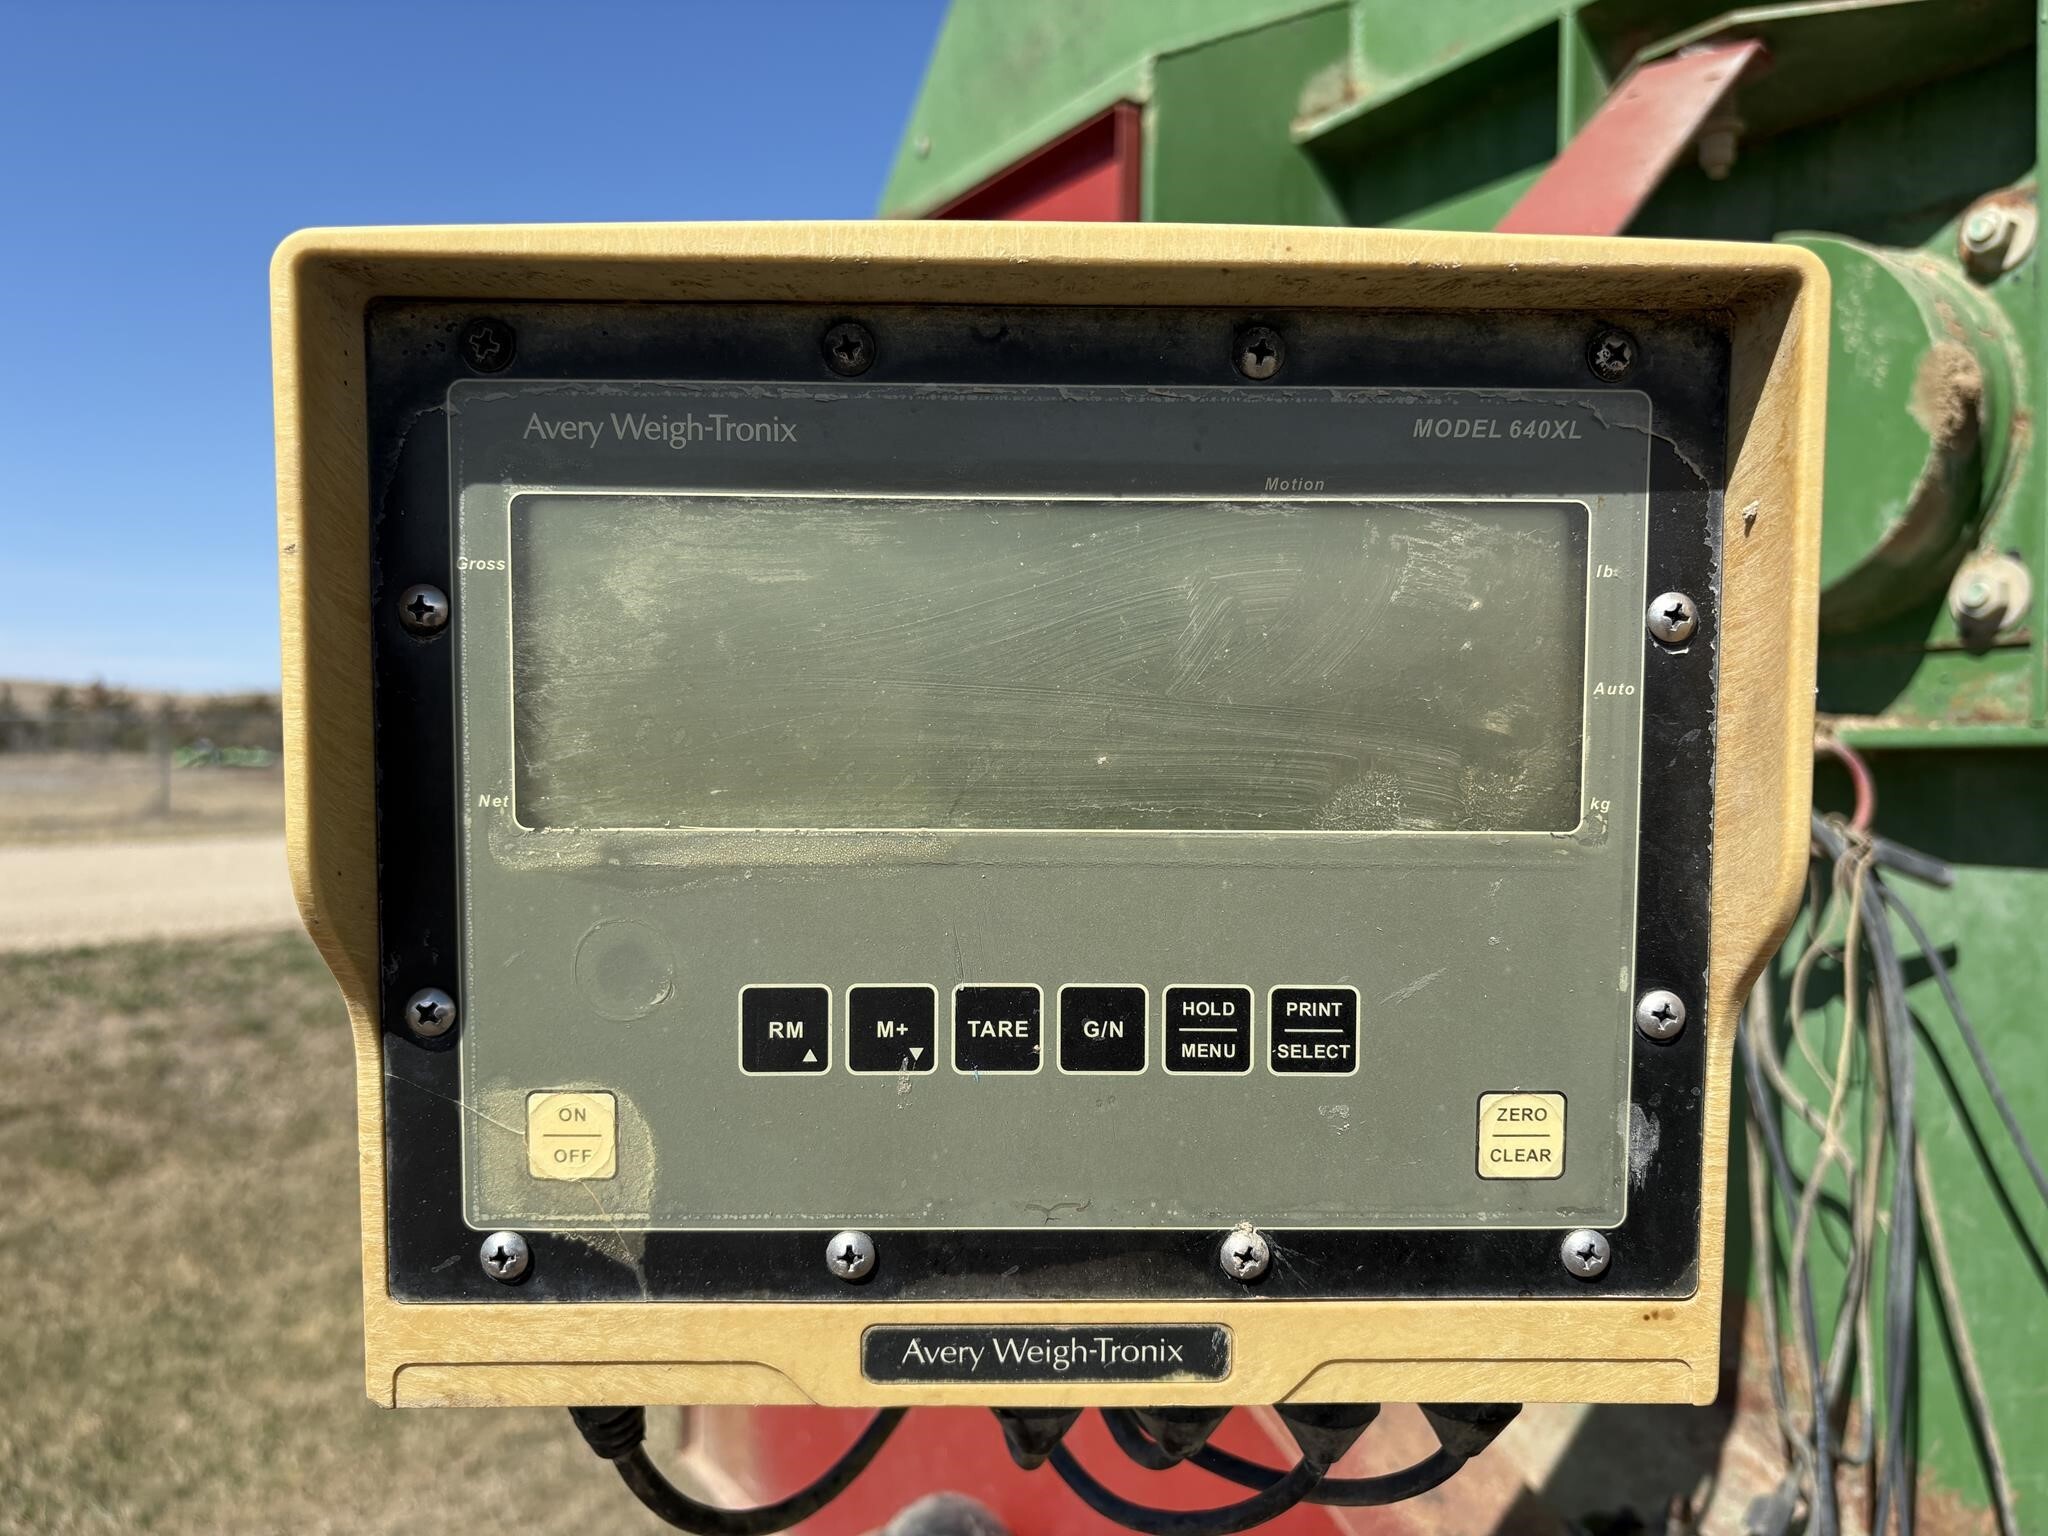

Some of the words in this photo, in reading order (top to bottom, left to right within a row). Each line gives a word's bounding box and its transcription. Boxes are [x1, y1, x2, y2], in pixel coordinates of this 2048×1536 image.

[522, 412, 604, 448] Avery
[610, 413, 798, 450] Weigh-Tronix
[1412, 418, 1502, 439] MODEL
[1508, 418, 1583, 440] 640XL
[1264, 477, 1325, 491] Motion
[456, 556, 506, 571] Gross
[1595, 564, 1613, 578] lb
[1592, 682, 1635, 696] Auto
[478, 794, 510, 808] Net
[1590, 797, 1611, 814] kg
[1182, 1001, 1236, 1017] HOLD
[1286, 1002, 1343, 1018] PRINT
[768, 1021, 805, 1039] RM
[876, 1020, 909, 1038] M+
[967, 1020, 1029, 1038] TARE
[1082, 1020, 1125, 1038] G/N
[1180, 1043, 1237, 1059] MENU
[1276, 1043, 1351, 1059] SELECT
[558, 1107, 587, 1122] ON
[1496, 1107, 1548, 1122] ZERO
[553, 1149, 593, 1163] OFF
[1489, 1148, 1552, 1163] CLEAR
[901, 1337, 985, 1372] Avery
[992, 1337, 1184, 1371] Weigh-Tronix
